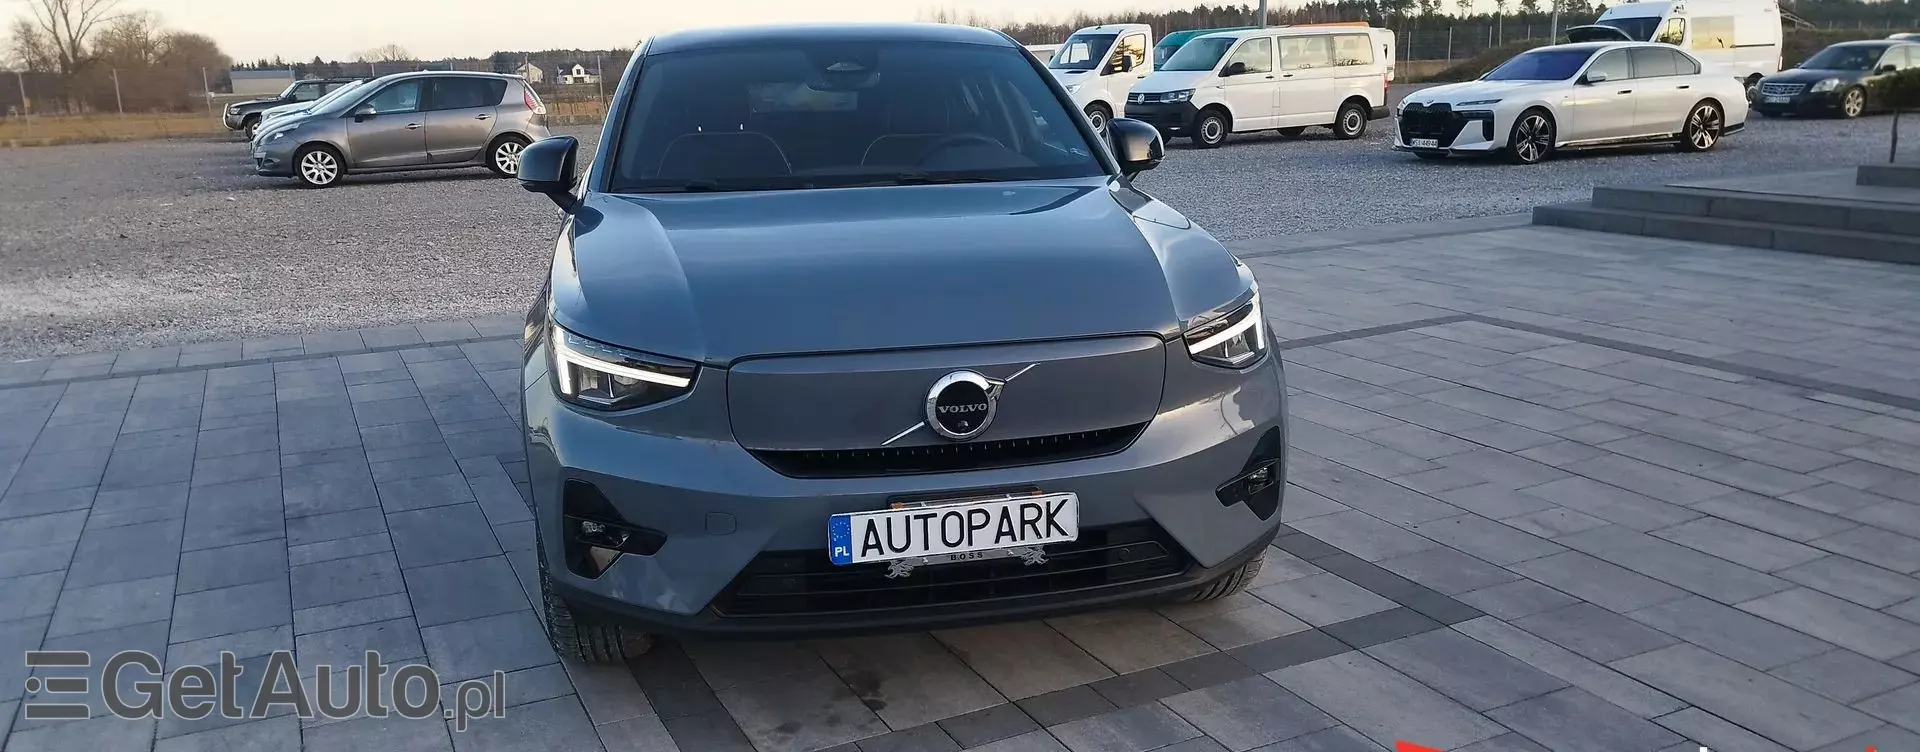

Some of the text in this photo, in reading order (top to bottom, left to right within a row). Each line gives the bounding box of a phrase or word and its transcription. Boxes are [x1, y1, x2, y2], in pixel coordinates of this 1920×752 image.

[937, 403, 987, 413] VOLVO
[834, 499, 1069, 557] PL AUTOPARK
[950, 552, 983, 561] BOSS
